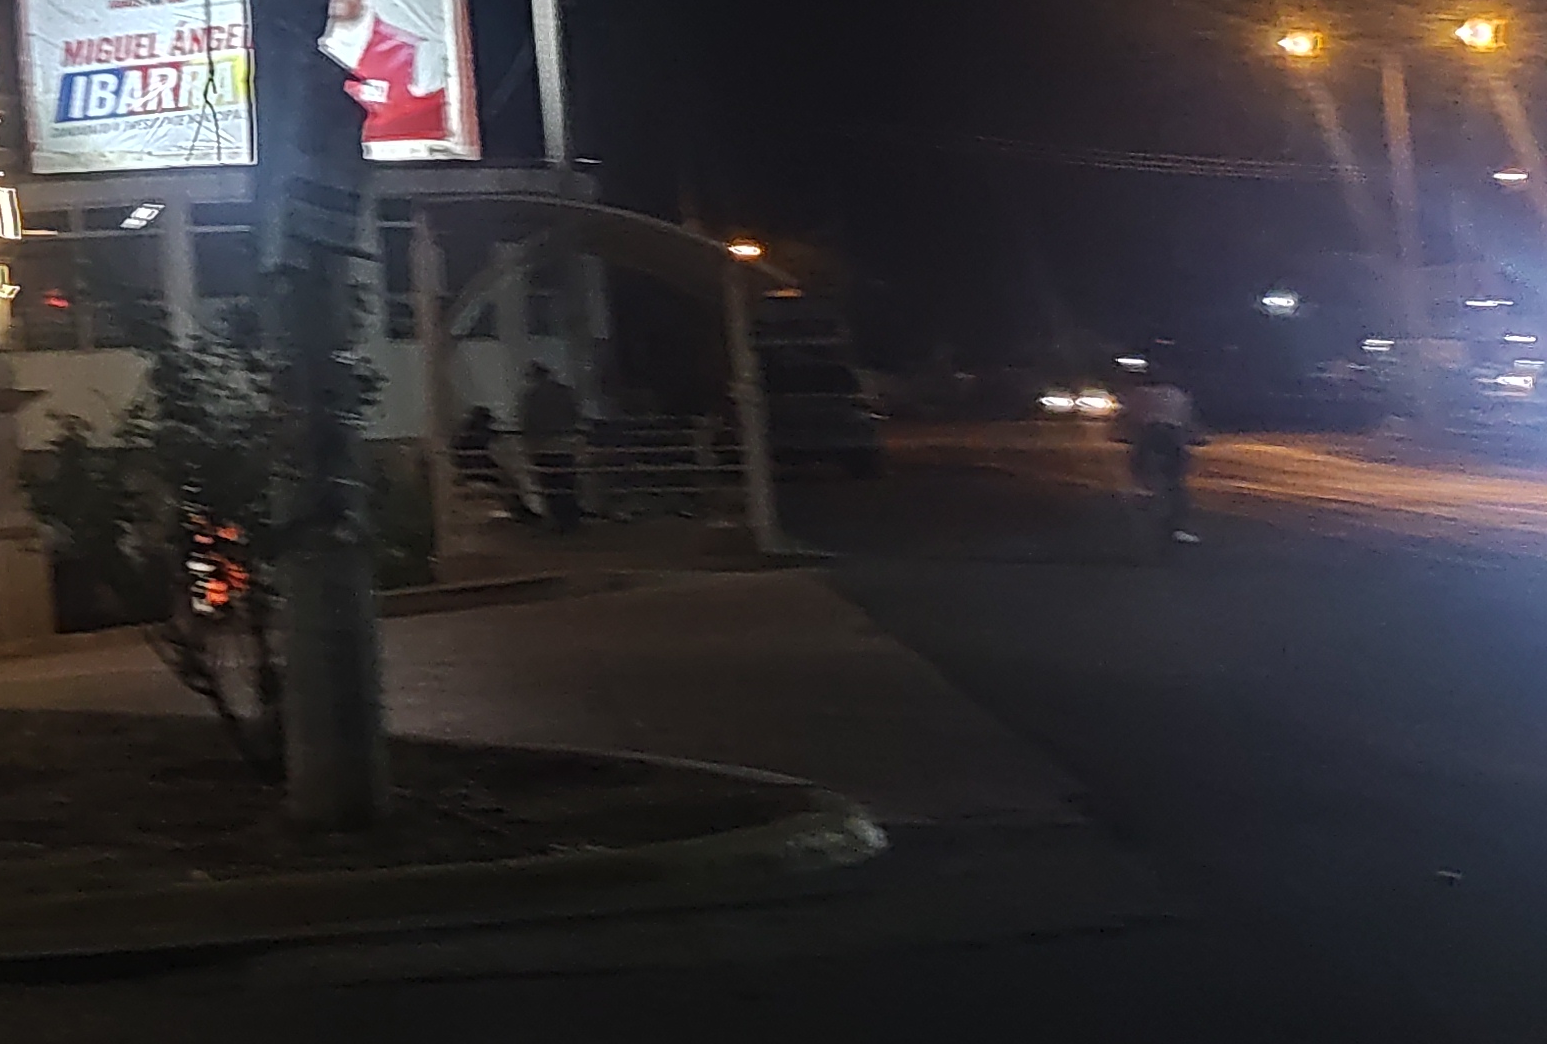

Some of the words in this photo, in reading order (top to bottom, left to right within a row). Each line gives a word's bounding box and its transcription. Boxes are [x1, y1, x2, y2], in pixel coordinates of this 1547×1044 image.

[63, 32, 159, 66] MIGUEL
[169, 20, 255, 56] ÁNGEL
[67, 61, 237, 119] IBARRA
